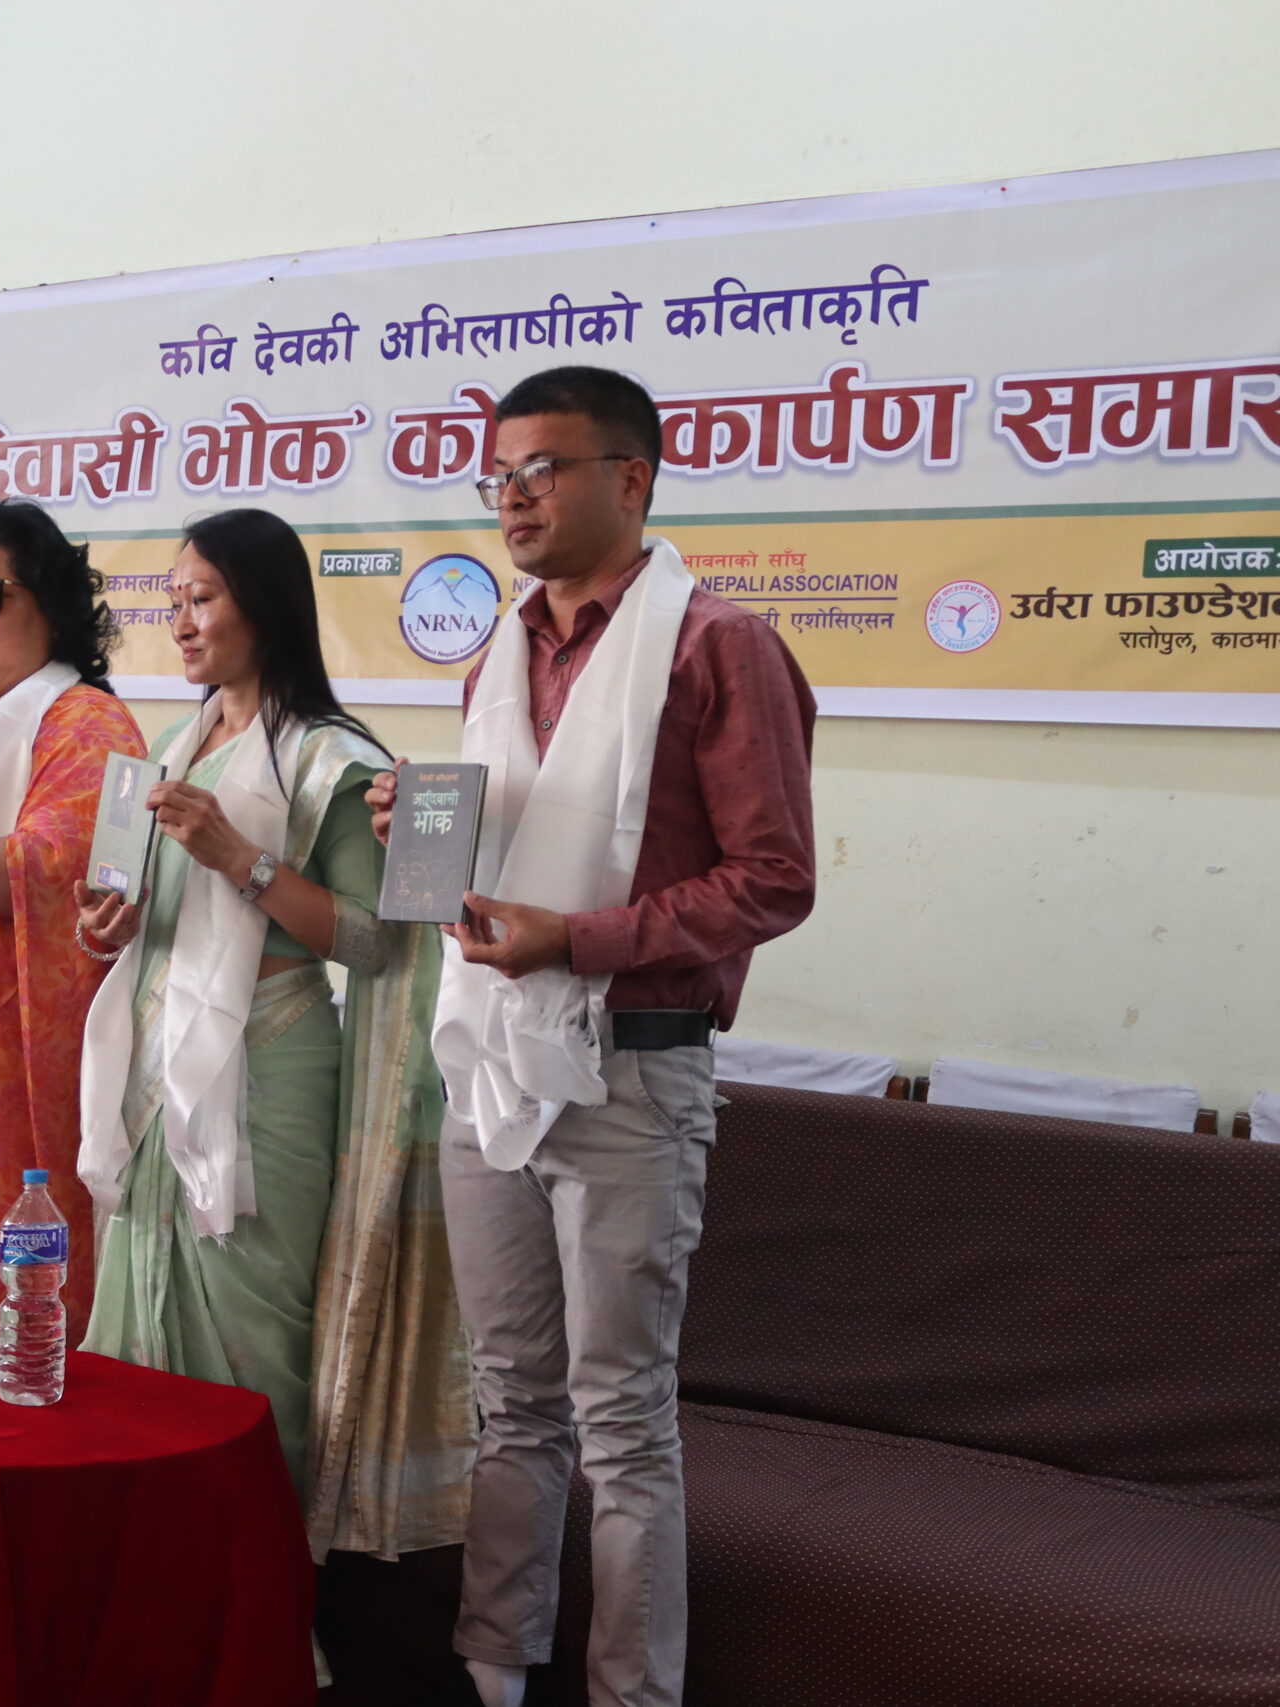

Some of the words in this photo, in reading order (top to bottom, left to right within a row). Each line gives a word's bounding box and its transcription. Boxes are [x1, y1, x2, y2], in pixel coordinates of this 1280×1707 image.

[160, 324, 236, 378] कवि
[254, 312, 359, 376] देवकी
[380, 292, 642, 360] अभिलाषीको
[665, 264, 929, 345] कविताकृति
[392, 387, 497, 478] को
[654, 367, 967, 470] कार्पण
[701, 575, 765, 592] NEPALI
[769, 573, 899, 592] ASSOCIATION
[1010, 586, 1094, 620] उर्वरा
[1104, 582, 1280, 620] फाउण्डेश
[416, 613, 479, 632] NRNA
[791, 606, 895, 634] एशोसिएसन
[1211, 631, 1280, 649] काठमा
[413, 803, 455, 835] भोक
